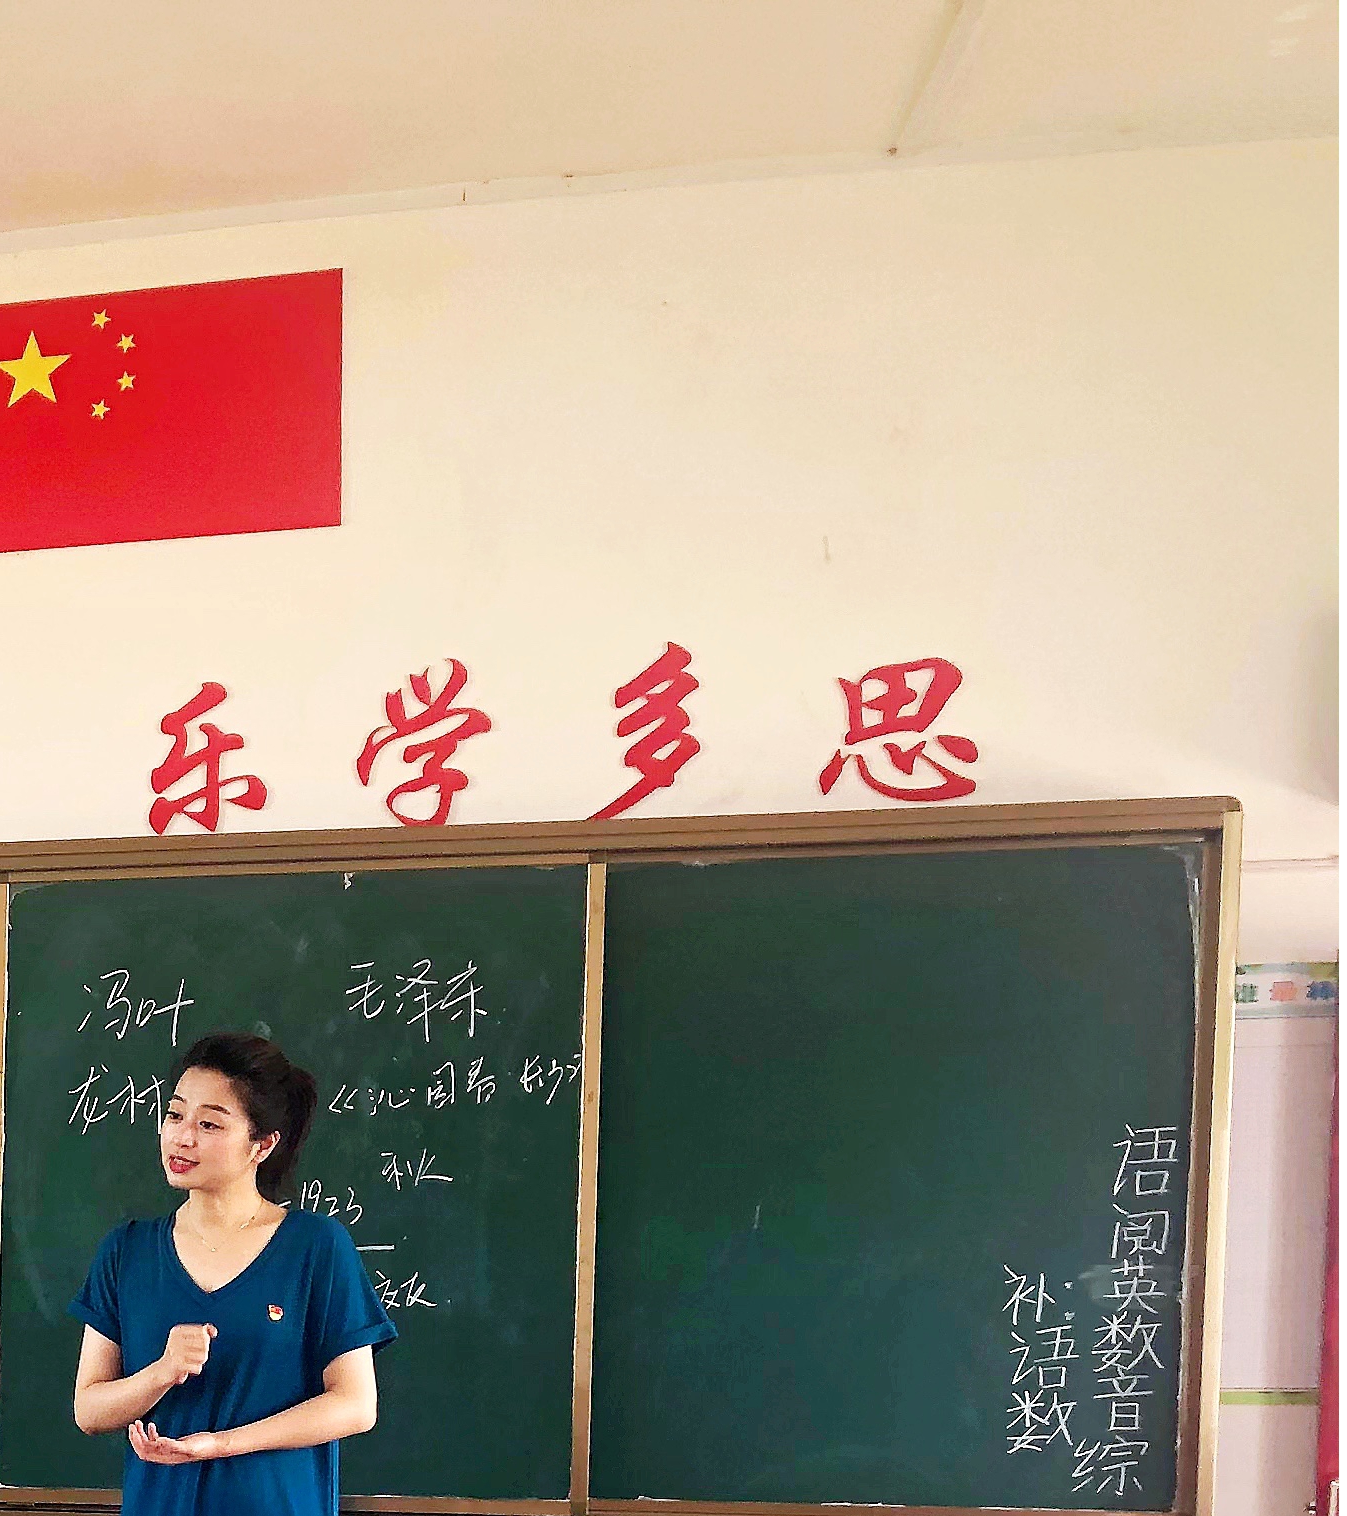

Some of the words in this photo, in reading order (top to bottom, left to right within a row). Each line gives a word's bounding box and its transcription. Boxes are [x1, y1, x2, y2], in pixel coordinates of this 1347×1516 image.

[148, 642, 979, 835] 乐学多思
[345, 958, 488, 1043] 毛泽东
